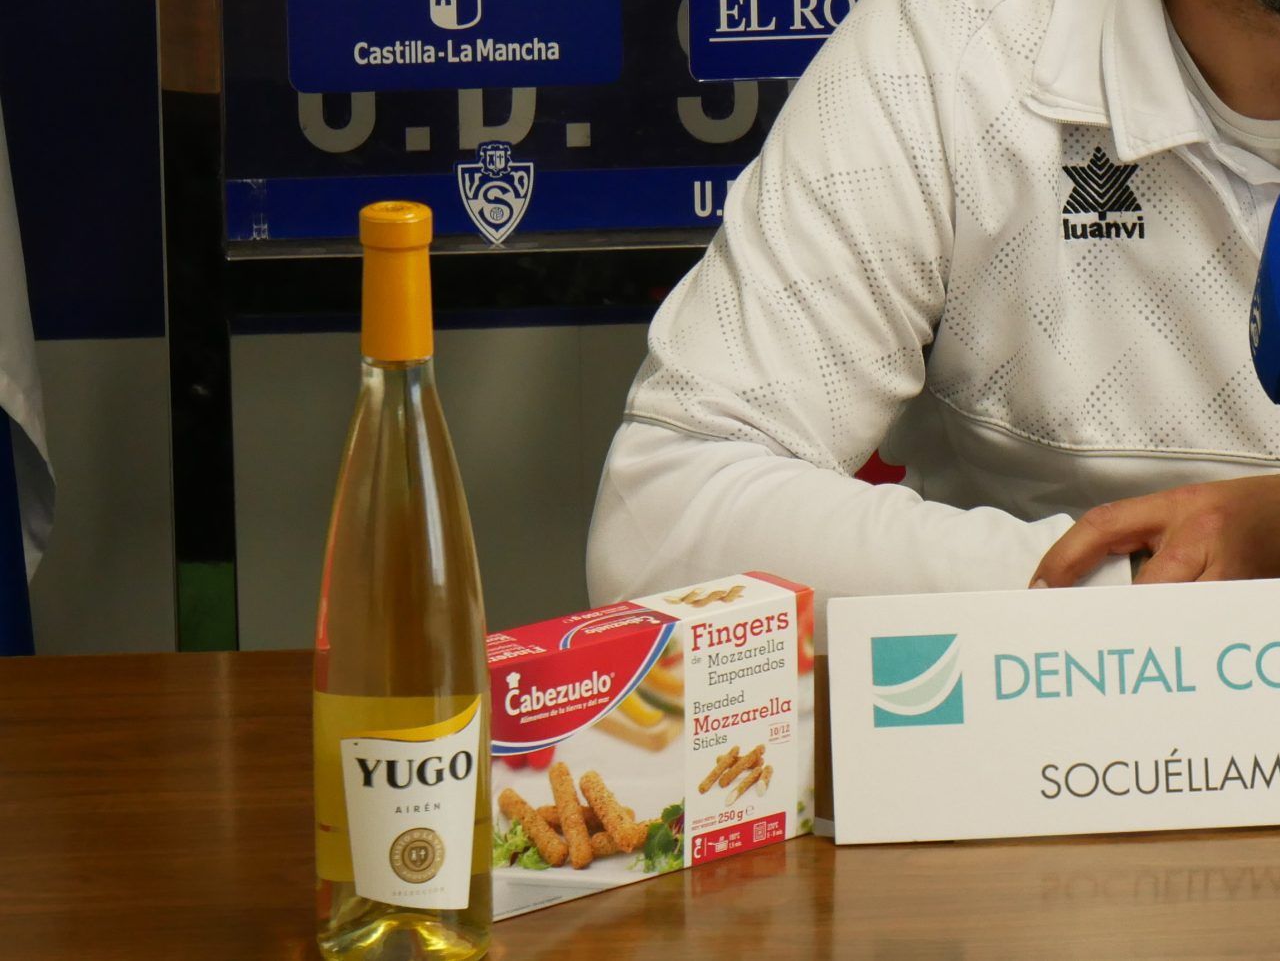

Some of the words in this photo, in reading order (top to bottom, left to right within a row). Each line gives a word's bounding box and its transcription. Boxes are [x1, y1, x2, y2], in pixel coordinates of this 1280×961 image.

[477, 38, 560, 63] Mancha
[1062, 215, 1145, 240] luanvi
[691, 611, 789, 652] Fingers
[707, 639, 785, 668] Mozzarella
[708, 657, 786, 686] Empanados
[994, 644, 1197, 702] DENTAL
[693, 690, 745, 715] Breaded
[693, 697, 792, 736] Mozzarella
[692, 733, 728, 751] Sticks
[355, 750, 473, 790] YUGO
[394, 801, 442, 815] AIRÉN
